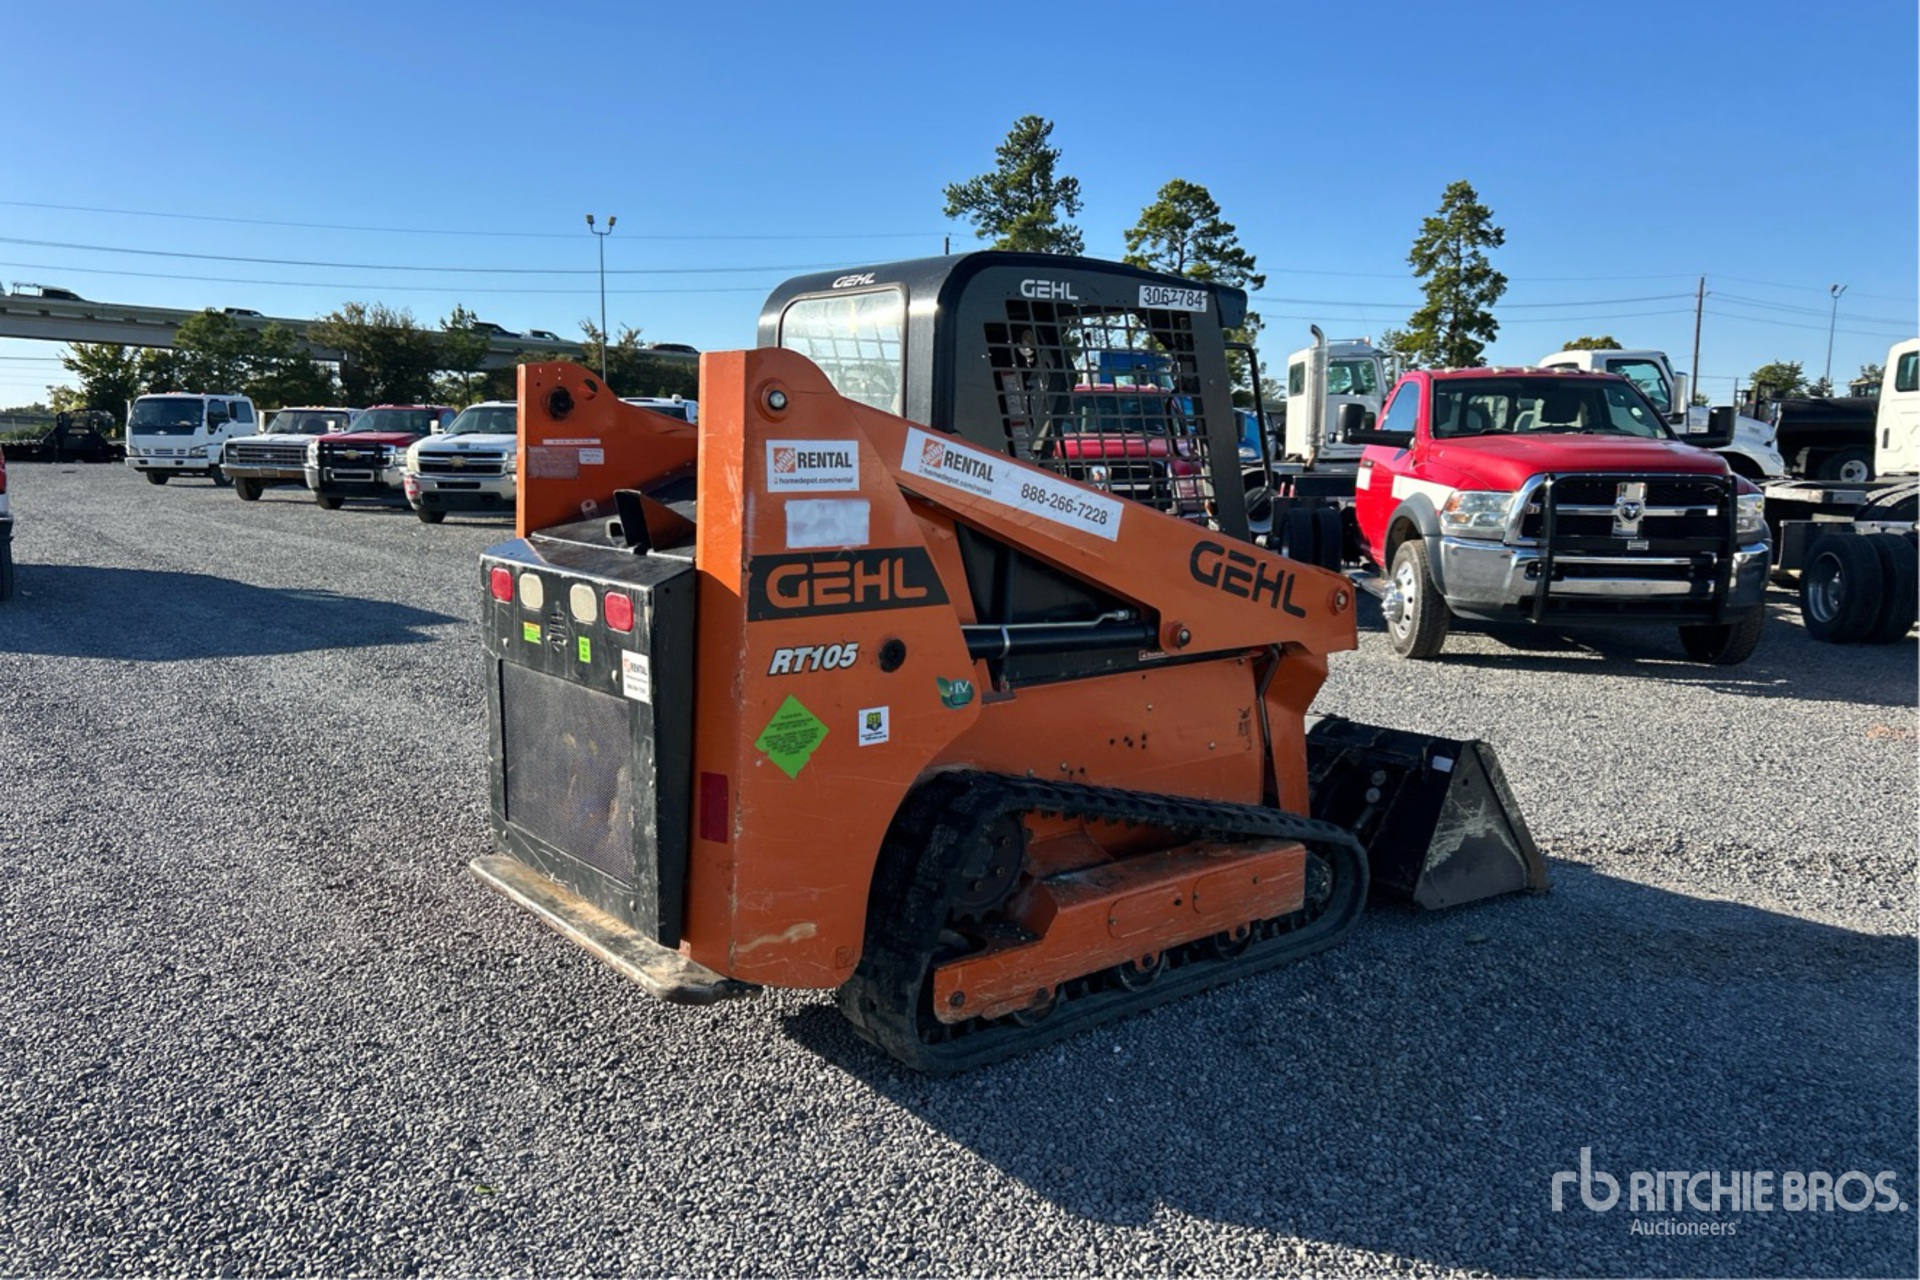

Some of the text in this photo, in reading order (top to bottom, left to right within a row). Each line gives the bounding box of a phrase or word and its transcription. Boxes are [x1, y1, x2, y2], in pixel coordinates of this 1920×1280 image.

[832, 272, 875, 289] GEHL
[1020, 279, 1079, 301] GEHL
[1143, 286, 1204, 308] 3067784
[797, 451, 853, 469] RENTAL
[943, 449, 994, 483] RENTAL
[1020, 482, 1109, 526] 888-266-7228
[765, 556, 929, 609] GEHL
[1189, 540, 1307, 618] GEHL
[767, 642, 860, 677] RT105
